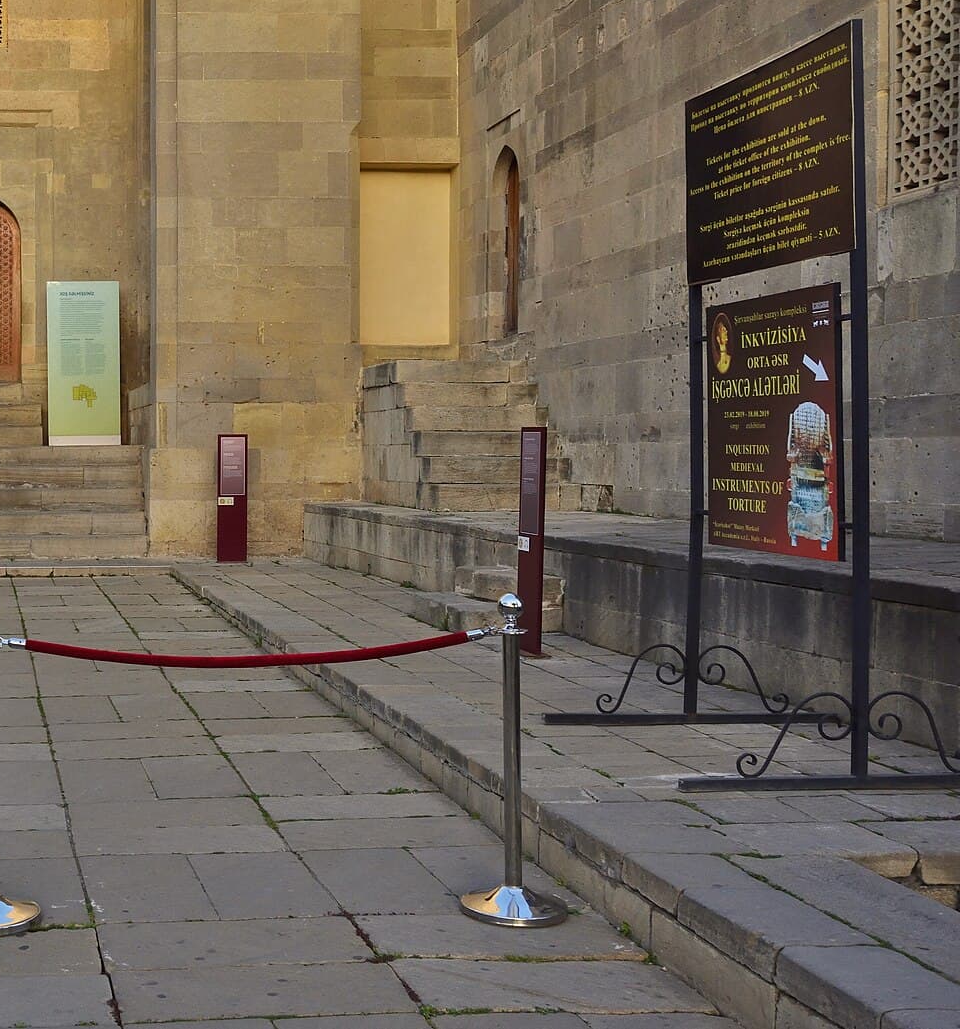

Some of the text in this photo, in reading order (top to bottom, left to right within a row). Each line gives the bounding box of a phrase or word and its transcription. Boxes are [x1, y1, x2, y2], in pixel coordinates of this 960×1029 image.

[706, 156, 723, 166] Tickets
[732, 148, 740, 156] the
[741, 137, 767, 153] exhibition
[767, 133, 777, 142] are
[778, 126, 790, 138] sold
[798, 121, 808, 131] the
[690, 186, 705, 196] Access
[710, 180, 719, 189] the
[719, 172, 744, 186] exhibition
[751, 165, 761, 174] the
[761, 157, 785, 172] territory
[786, 151, 793, 162] of
[793, 149, 803, 160] the
[803, 141, 828, 156] complex
[724, 163, 733, 172] the
[733, 157, 748, 169] ticket
[748, 151, 763, 163] office
[770, 144, 780, 155] the
[714, 189, 729, 201] Ticket
[729, 185, 743, 197] price
[744, 181, 752, 190] for
[751, 175, 771, 188] foreign
[772, 167, 793, 182] citizens
[741, 324, 807, 349] İNKVİZİSİYA
[747, 355, 771, 370] ORTA
[711, 368, 801, 404] İŞGƏNCƏ ALƏTLƏRİ
[725, 444, 770, 457] INQUISITION
[730, 462, 765, 473] MEDIEVAL
[712, 477, 785, 495] INSTRUMENTS OF
[727, 497, 767, 514] TORTURE
